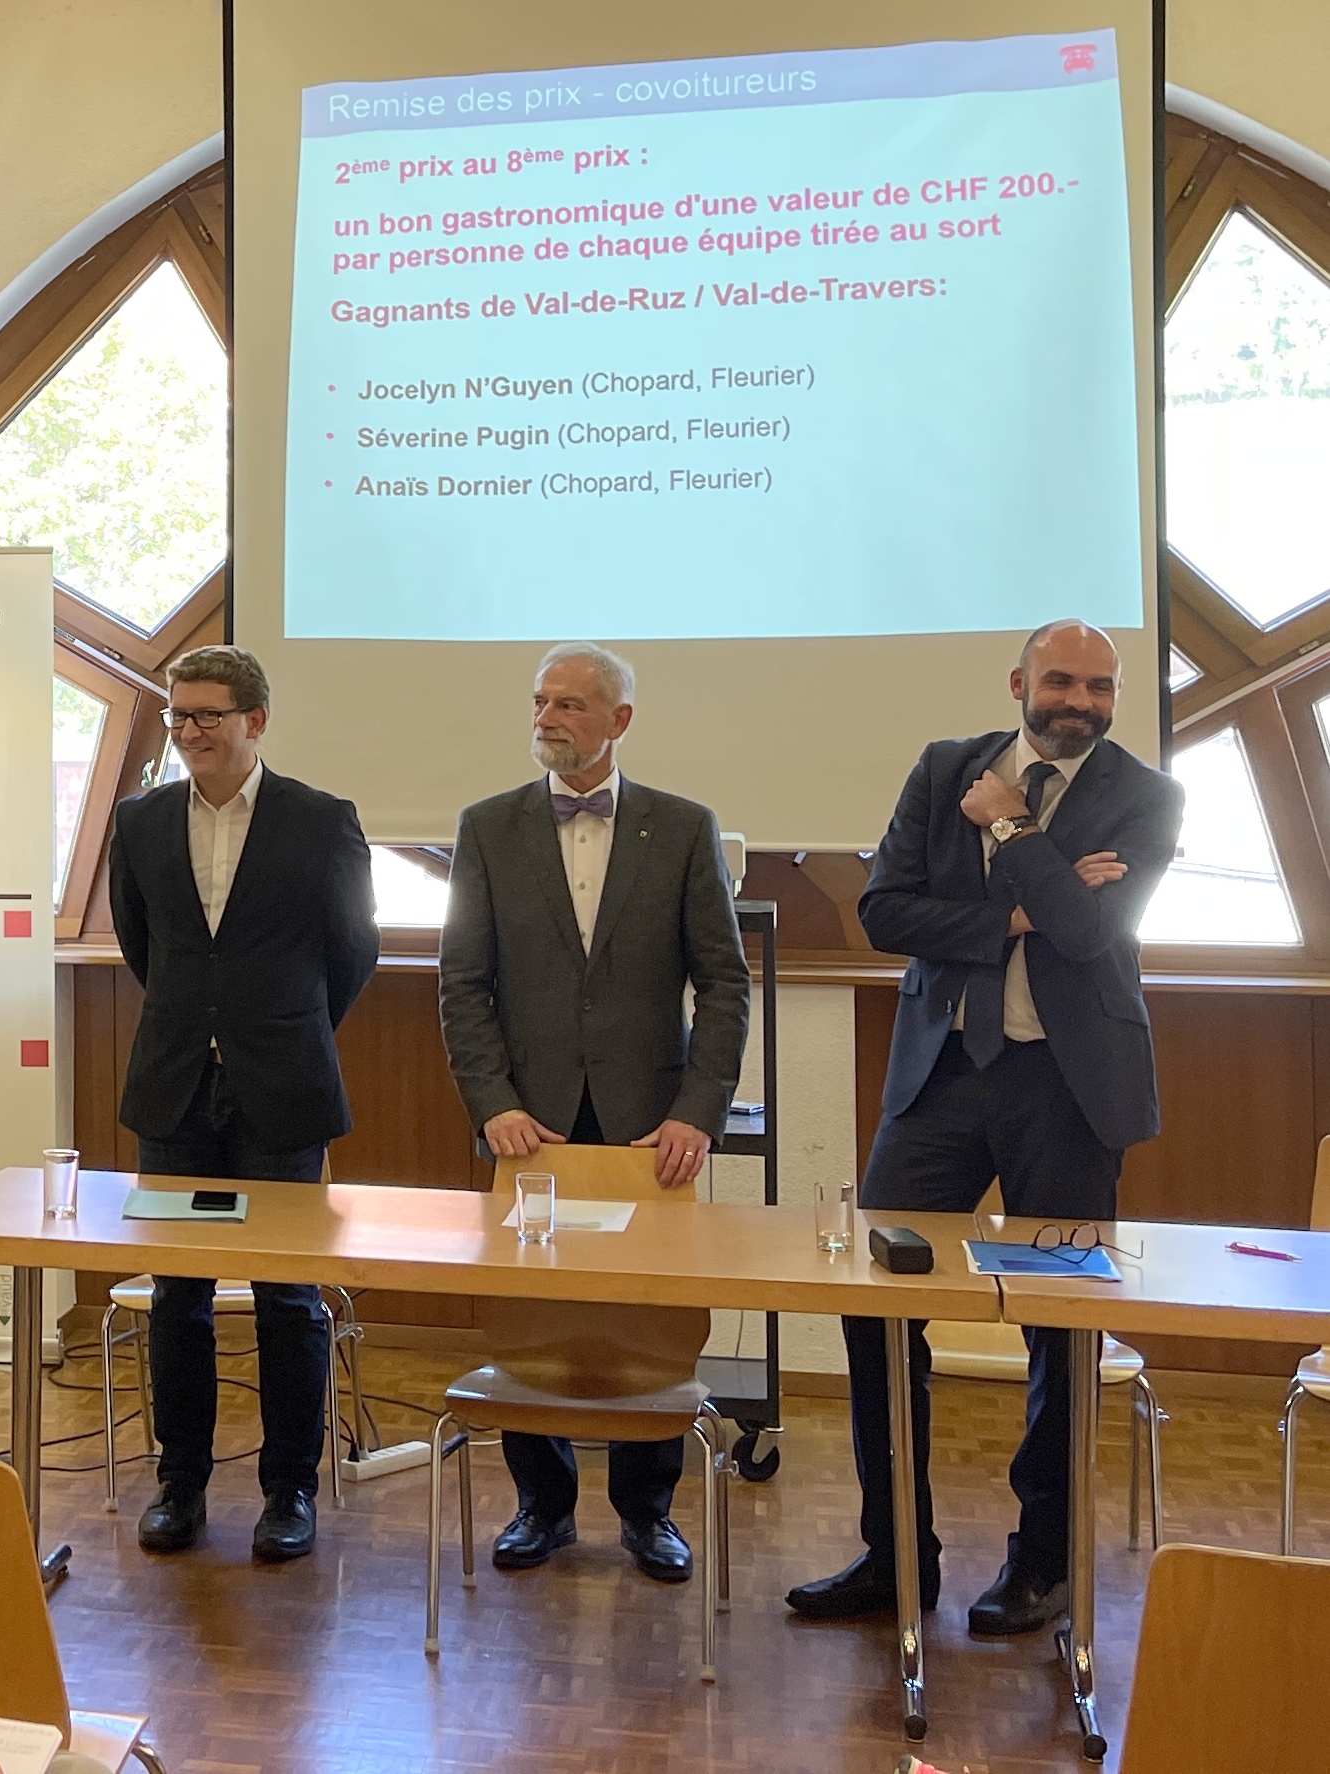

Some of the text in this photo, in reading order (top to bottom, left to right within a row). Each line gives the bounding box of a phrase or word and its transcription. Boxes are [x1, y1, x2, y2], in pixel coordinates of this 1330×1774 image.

[329, 91, 445, 123] Remise
[457, 87, 512, 113] des
[524, 82, 582, 115] prix
[616, 67, 817, 104] covoitureurs
[335, 156, 391, 185] 2ème
[399, 155, 453, 184] prix
[462, 156, 497, 176] au
[507, 147, 565, 174] 8ème
[574, 145, 630, 174] prix
[334, 172, 1080, 237] un bon gastronomique d'une valeur de CHF 200.-
[333, 213, 1002, 276] par personne de chaque équipe tirée au sort
[330, 277, 948, 329] Gagnants de Val-de-Ruz / Val-de-Travers:
[357, 379, 456, 404] Jocelyn
[581, 368, 702, 399] (Chopard,
[711, 364, 816, 390] Fleurier)
[357, 416, 792, 450] Séverine Pugin (Chopard, Fleurier)
[354, 466, 773, 500] Anaïs Dornier (Chopard, Fleurier)
